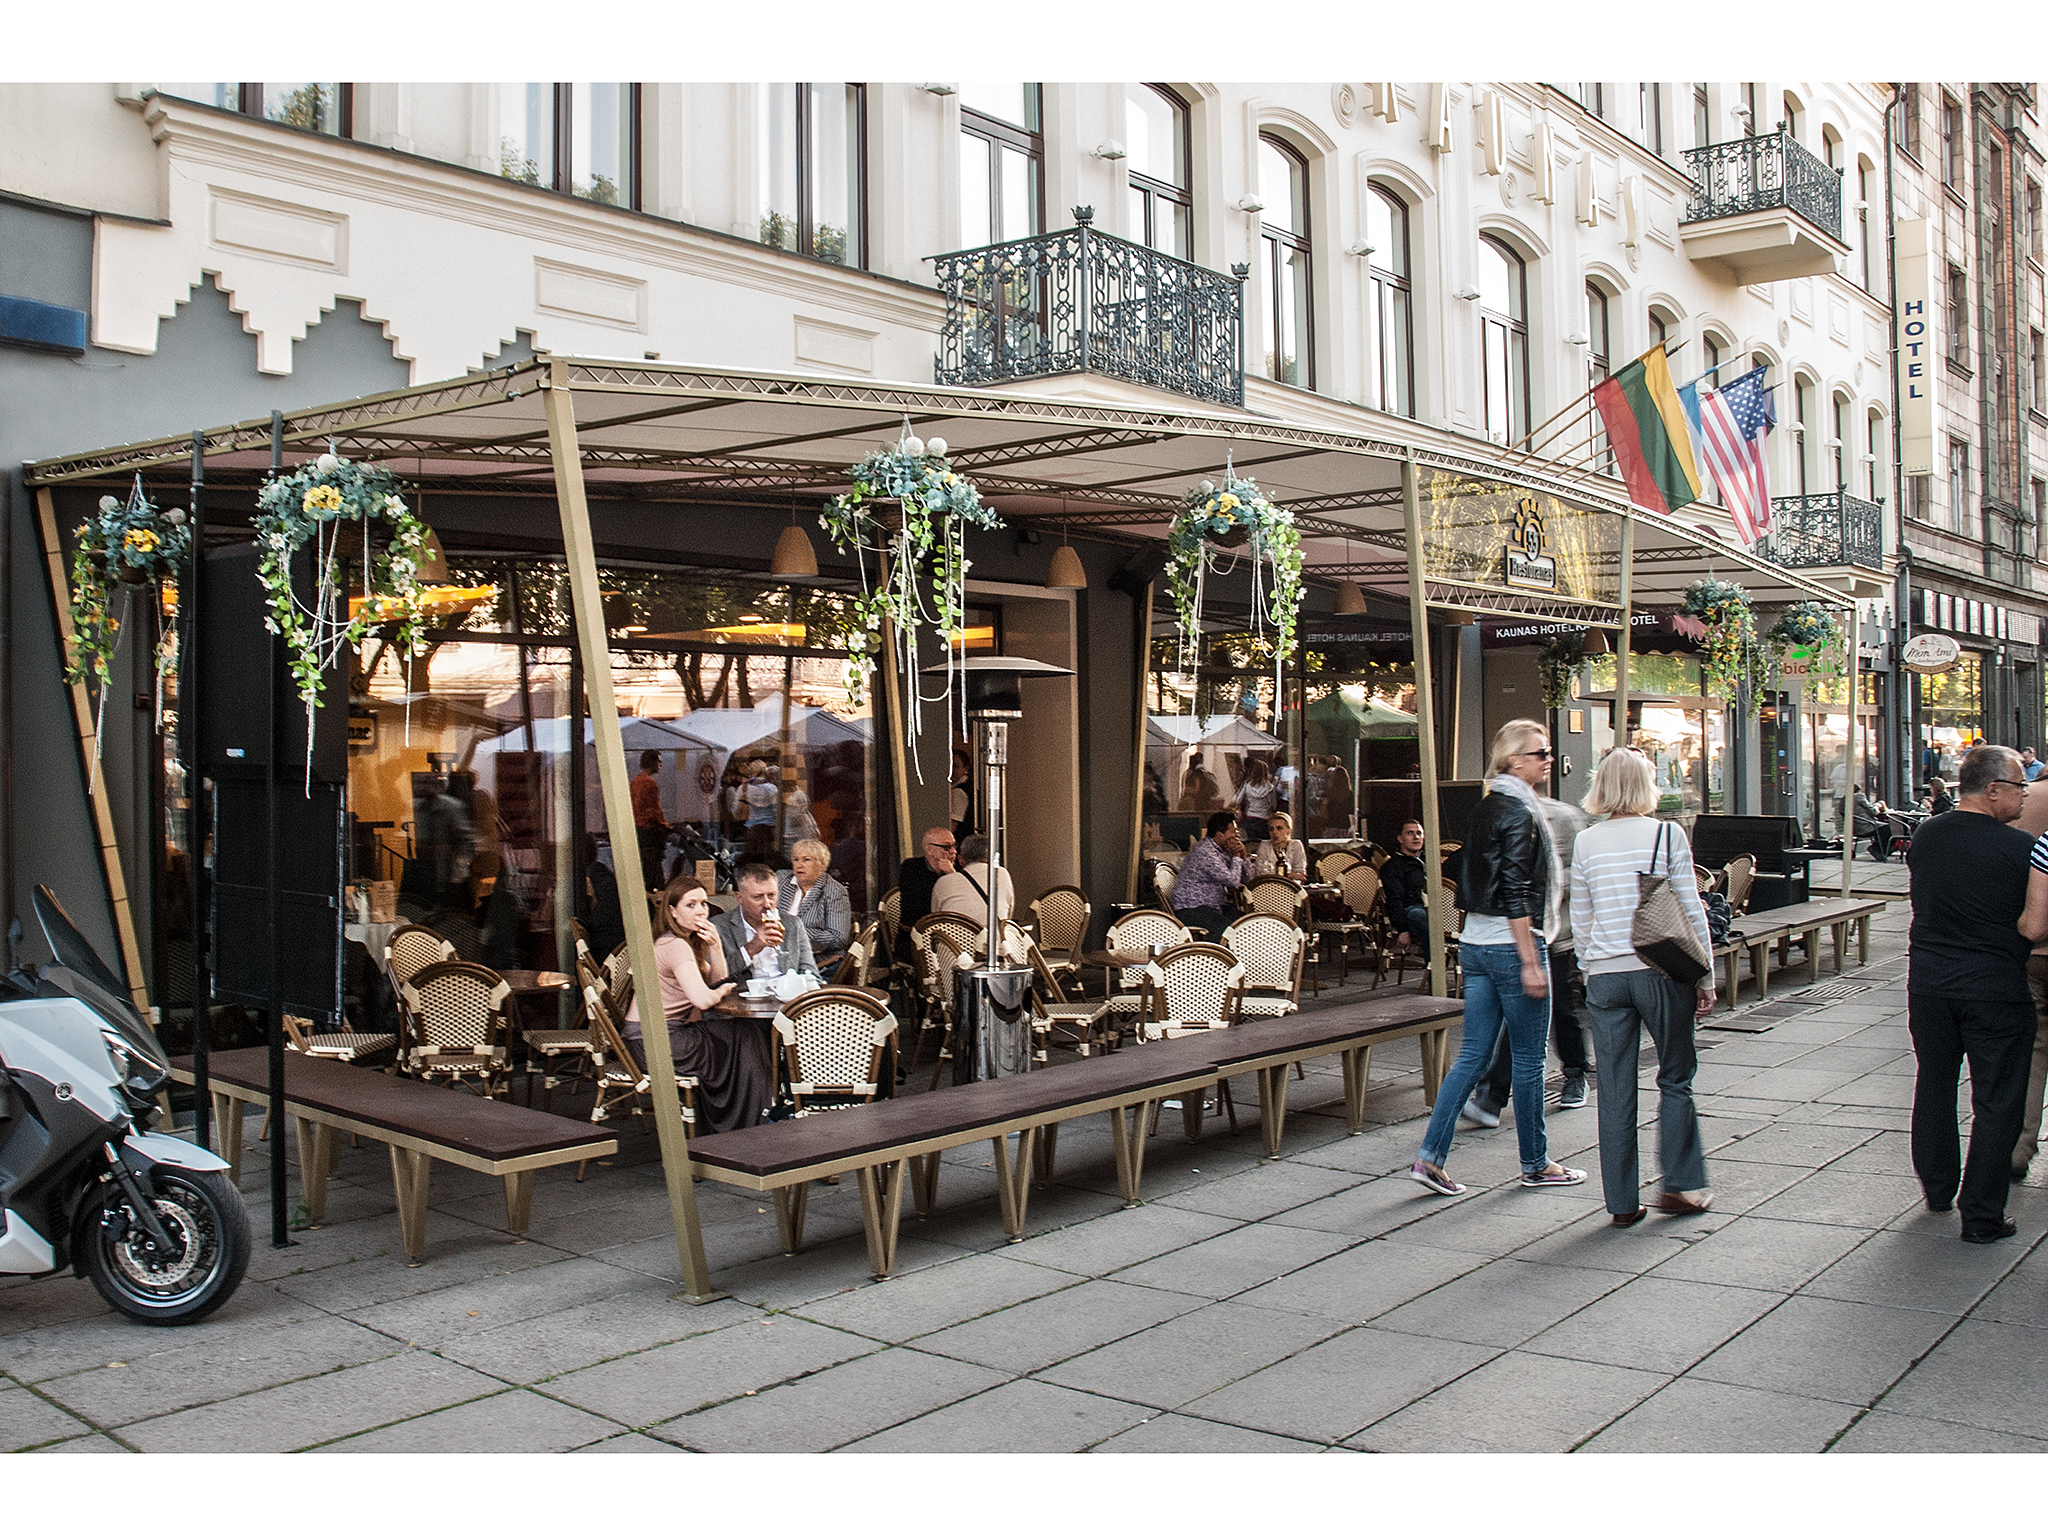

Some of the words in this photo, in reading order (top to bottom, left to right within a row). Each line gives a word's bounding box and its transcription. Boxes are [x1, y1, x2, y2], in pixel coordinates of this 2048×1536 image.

[1904, 300, 1925, 398] HOTEL
[1509, 557, 1553, 581] Restoranas
[1496, 625, 1538, 638] KAUNAS
[1540, 623, 1576, 634] HOTEL
[1630, 615, 1659, 626] OTEL
[1906, 647, 1930, 658] Mon
[1933, 646, 1954, 657] Ami
